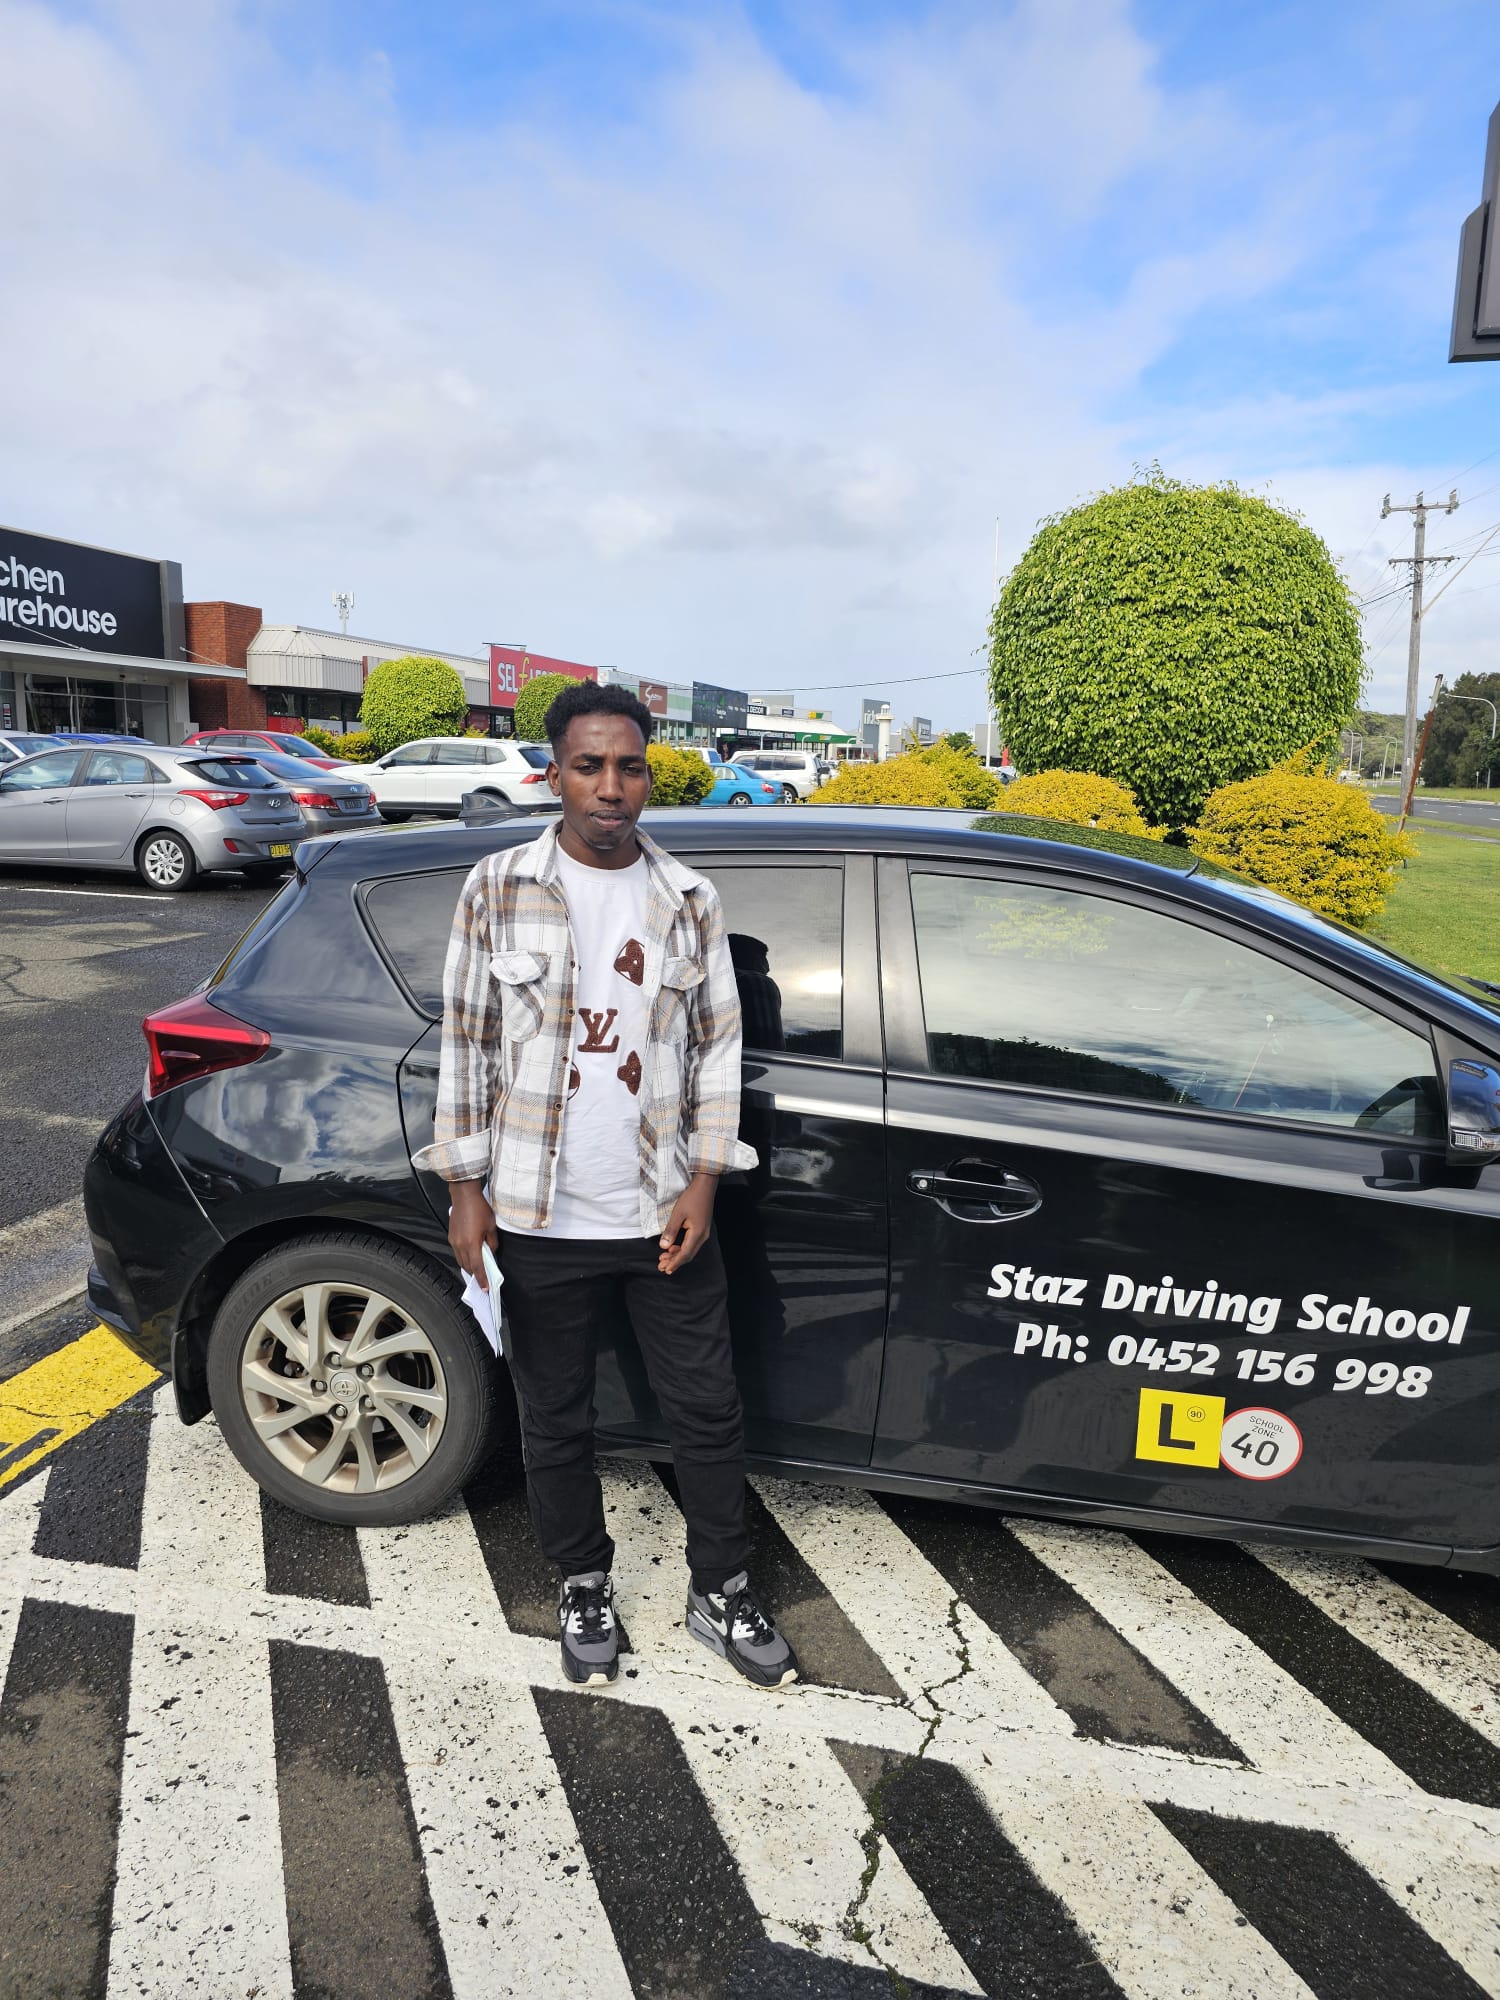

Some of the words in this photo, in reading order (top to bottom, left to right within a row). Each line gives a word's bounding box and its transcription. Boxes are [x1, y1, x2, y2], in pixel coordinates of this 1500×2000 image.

[0, 555, 65, 596] chen
[987, 1264, 1088, 1306] Staz
[1102, 1274, 1281, 1334] Driving
[1297, 1294, 1471, 1345] School
[1014, 1323, 1088, 1363] Ph:
[1108, 1335, 1220, 1376] 0452
[1236, 1349, 1318, 1386] 156
[1333, 1359, 1432, 1398] 998
[1158, 1403, 1196, 1451] L
[1190, 1410, 1203, 1419] 90
[1249, 1415, 1285, 1434] SCHOOL
[1251, 1426, 1277, 1439] ZONE
[1231, 1432, 1280, 1466] 40
